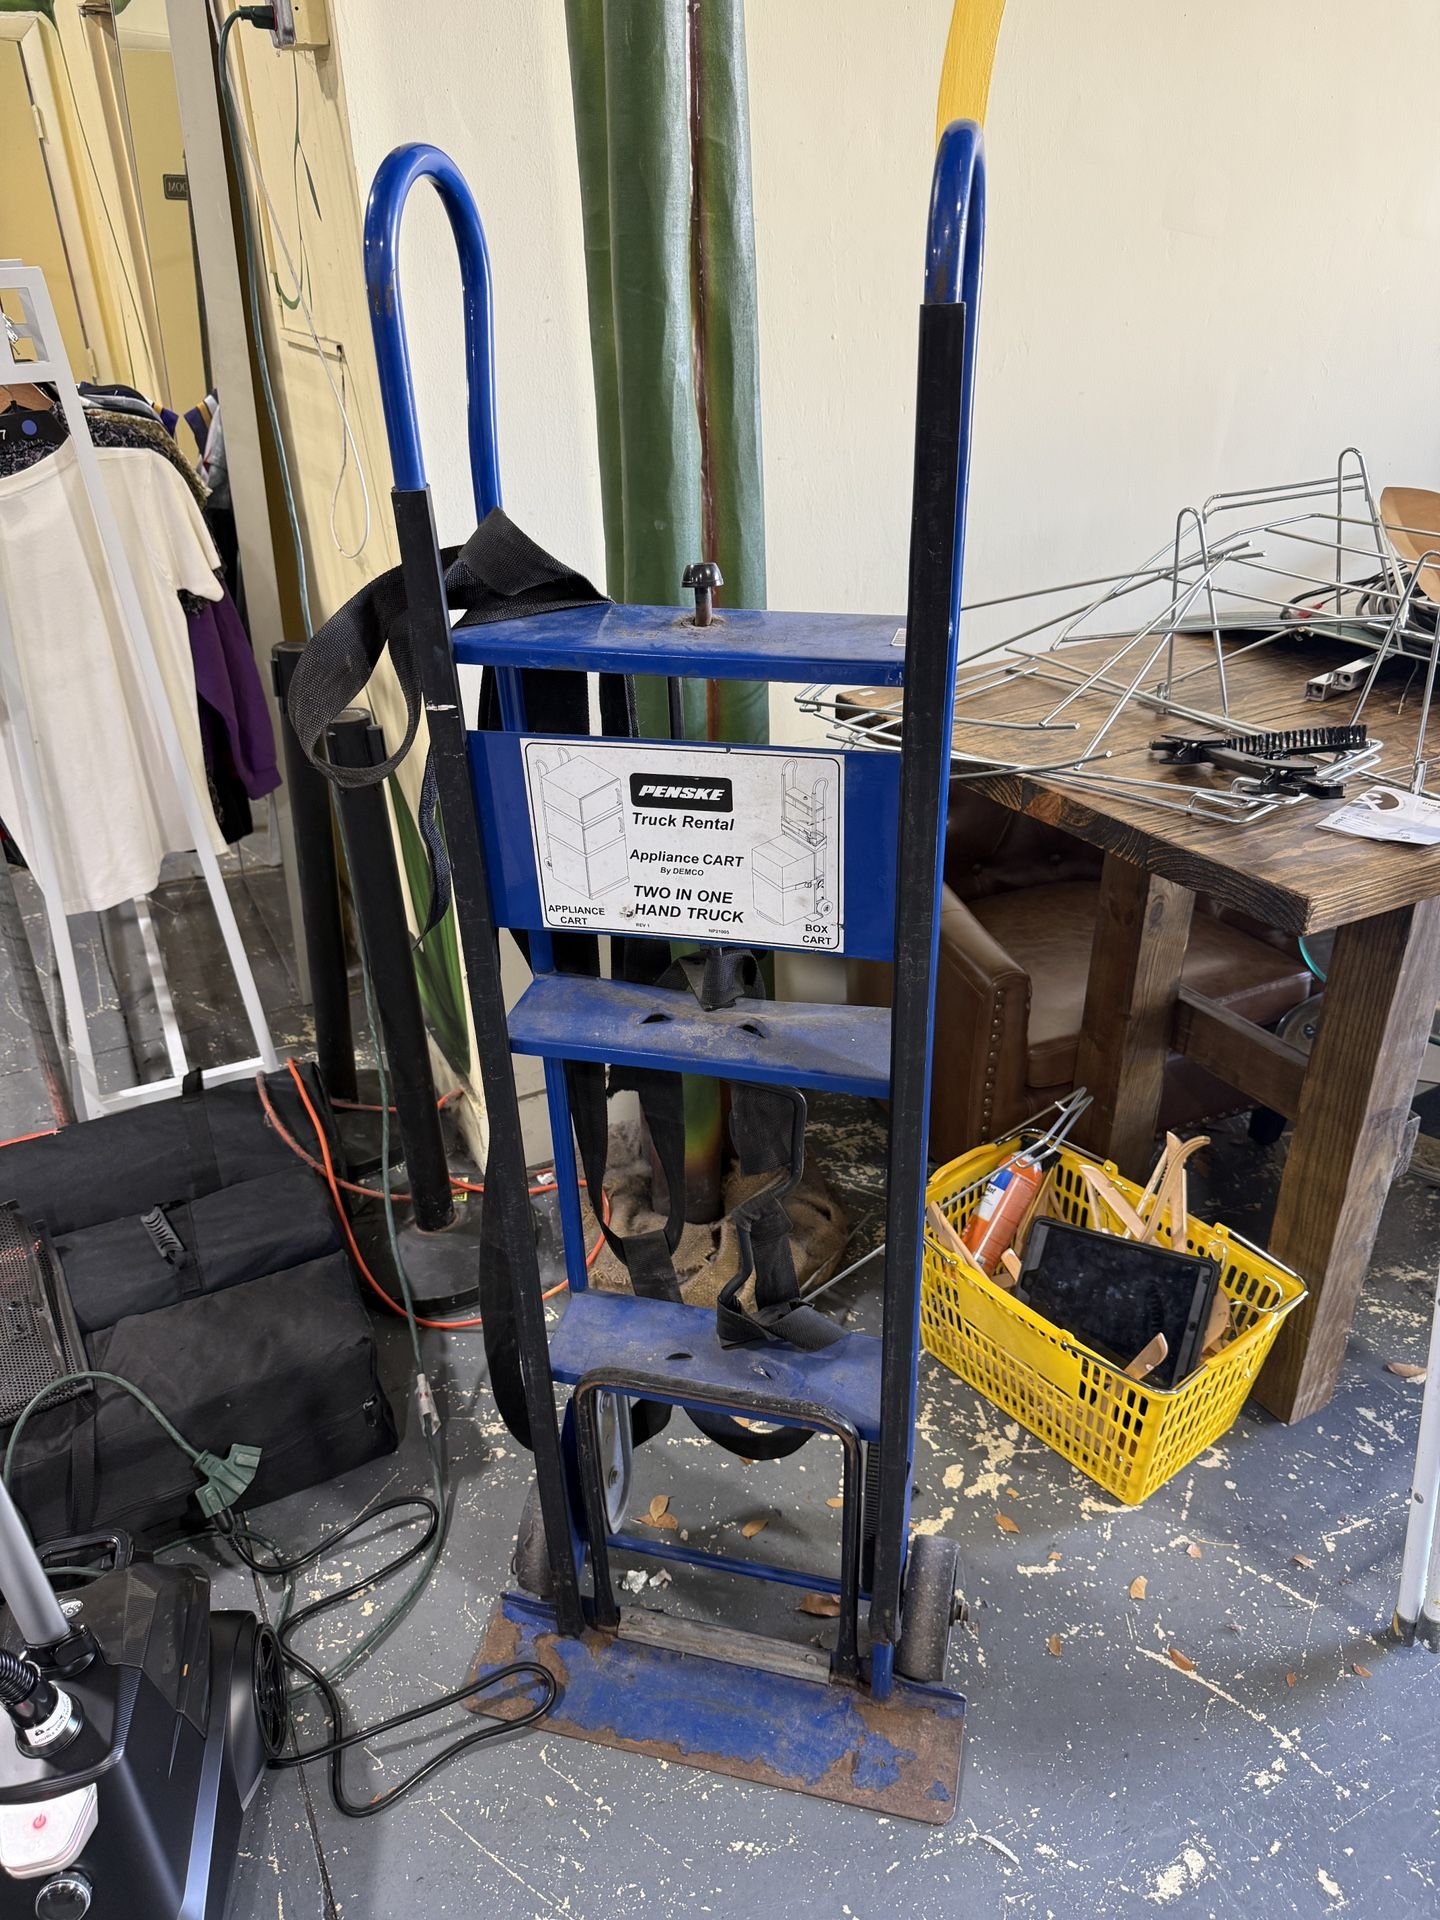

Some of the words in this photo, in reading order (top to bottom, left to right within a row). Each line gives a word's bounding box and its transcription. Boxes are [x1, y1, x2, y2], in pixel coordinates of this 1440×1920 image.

[638, 785, 726, 801] PENSKE
[632, 812, 677, 827] Truck
[682, 815, 735, 831] Rental
[629, 849, 700, 864] Appliance
[703, 854, 745, 868] CART
[660, 866, 672, 876] By
[673, 867, 704, 877] DEMCO
[634, 885, 671, 899] TWO
[676, 888, 692, 901] IN
[697, 890, 734, 904] ONE
[548, 904, 606, 916] APPLIANCE
[635, 903, 682, 918] HAND
[687, 907, 745, 924] TRUCK
[560, 916, 588, 926] CART
[805, 924, 829, 934] BOX
[802, 935, 832, 945] CART
